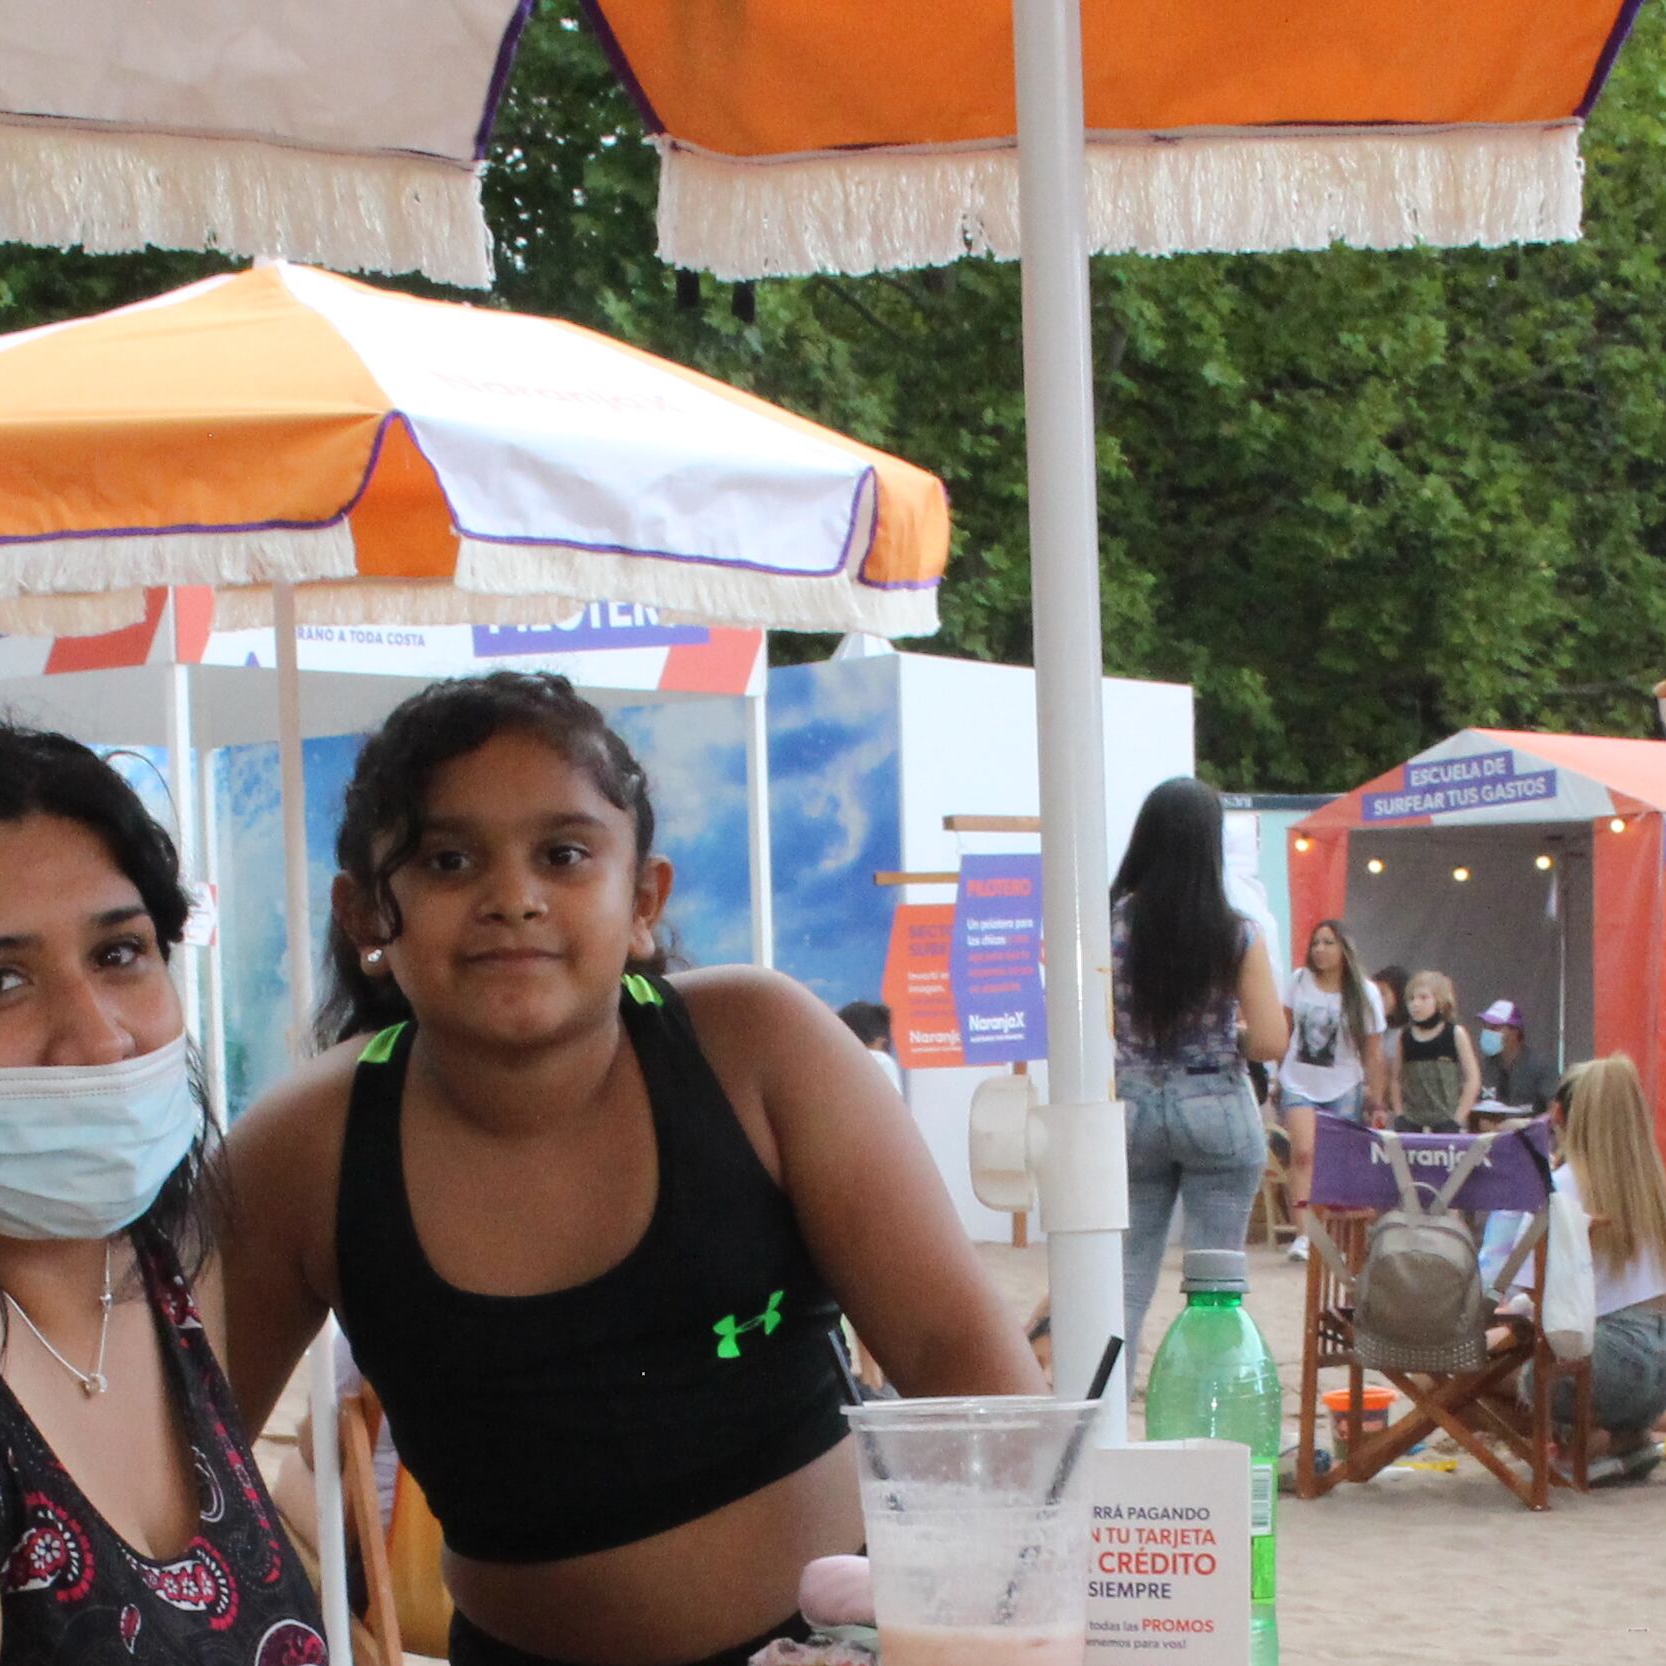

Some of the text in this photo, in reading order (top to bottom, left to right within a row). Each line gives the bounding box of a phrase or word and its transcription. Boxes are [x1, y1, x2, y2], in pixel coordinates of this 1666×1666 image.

[297, 626, 334, 641] RANO
[350, 630, 383, 645] TODA
[387, 632, 426, 647] COSTA
[1411, 757, 1506, 787] ESCUELA DE
[1374, 776, 1546, 816] SURFEAR TUS GASTOS
[969, 1012, 1025, 1034] NaranjaX
[1093, 1504, 1210, 1520] RRÁ PAGANDO
[1106, 1527, 1130, 1544] TU
[1135, 1528, 1217, 1549] TARJETA
[1098, 1547, 1217, 1575] CRÉDITO
[1088, 1581, 1172, 1599] SIEMPRE
[1089, 1618, 1215, 1633] todas las PROMOS
[1086, 1638, 1187, 1650] enemos para vos!
